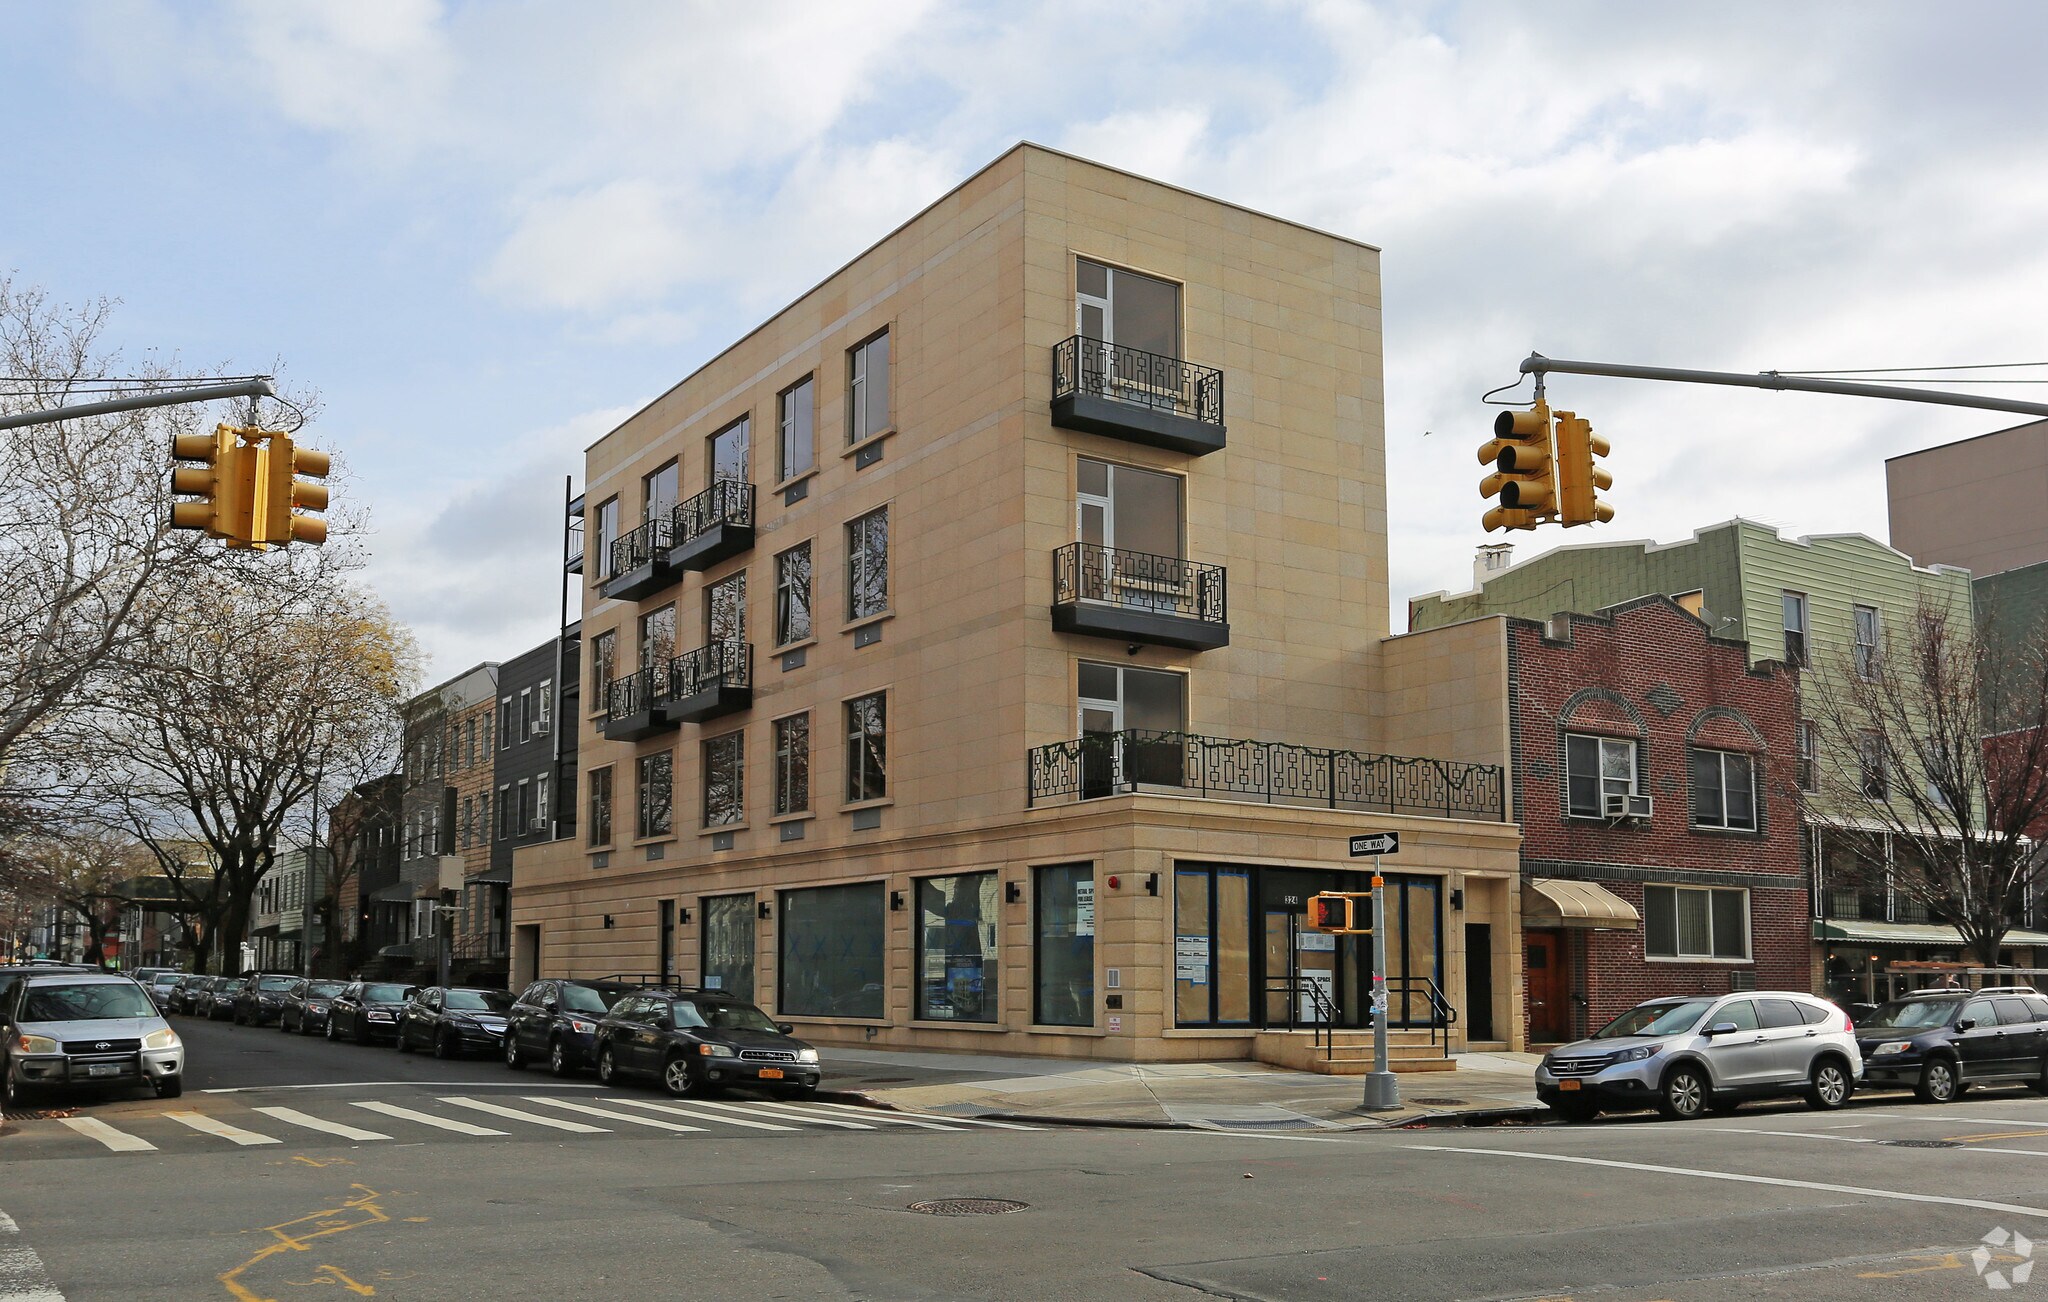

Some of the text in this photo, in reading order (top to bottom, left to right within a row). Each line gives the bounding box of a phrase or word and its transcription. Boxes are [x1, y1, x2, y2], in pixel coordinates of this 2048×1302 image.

[1354, 839, 1385, 851] ONE WAY
[1285, 896, 1298, 904] 324
